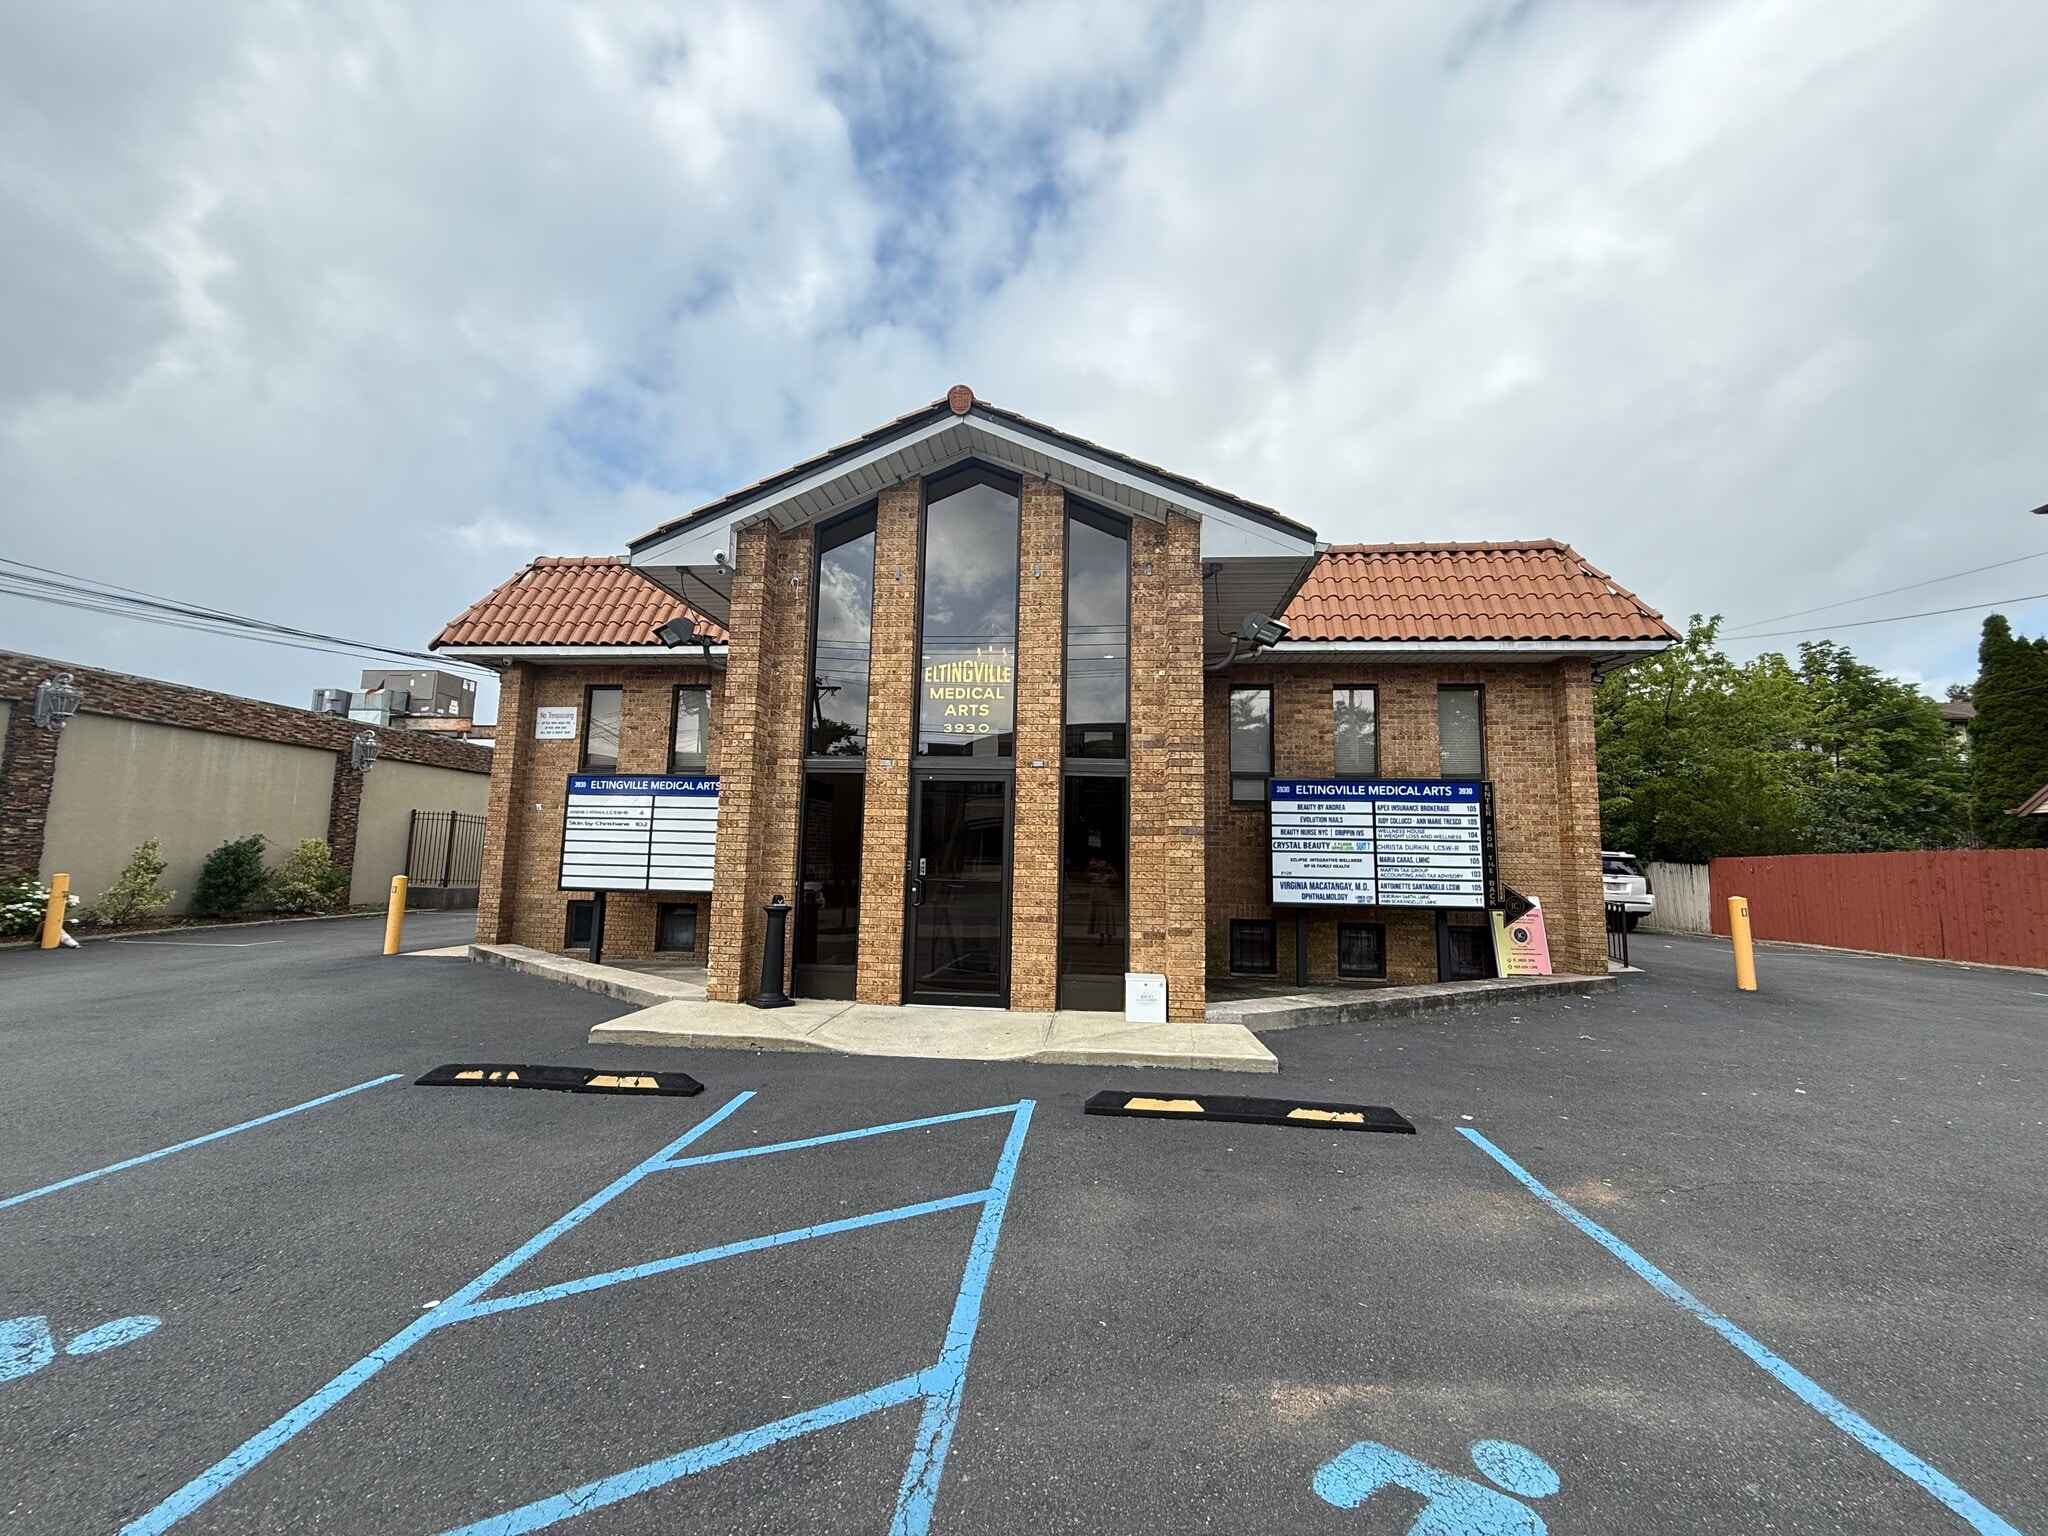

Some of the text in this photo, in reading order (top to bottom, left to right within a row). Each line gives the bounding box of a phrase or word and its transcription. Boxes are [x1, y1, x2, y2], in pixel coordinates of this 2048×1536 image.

[924, 659, 1011, 683] ELTINGVILLE
[929, 687, 1005, 700] MEDICAL
[944, 704, 990, 717] ARTS
[540, 711, 575, 720] No Trespassing
[943, 723, 989, 733] 3930
[590, 780, 649, 790] ELTINGVILLE
[650, 781, 695, 791] MEDICAL
[696, 781, 721, 791] ARTS
[1276, 784, 1473, 796] 3930 ELTINGVILLE MEDICAL ARTS 3930
[1297, 803, 1346, 811] BEAUTY BY ANDREA
[1377, 804, 1390, 812] APEX
[1391, 804, 1419, 812] INSURANCE
[1466, 805, 1477, 813] 105
[1328, 816, 1344, 824] NAILS
[1467, 818, 1478, 826] 105
[1280, 828, 1299, 836] BEAUTY
[1300, 828, 1317, 836] NURSE
[1318, 828, 1329, 836] NYC
[1334, 829, 1356, 837] DRIPPIN
[1355, 829, 1365, 837] IVS
[1467, 831, 1478, 839] 104
[1272, 841, 1331, 850] CRYSTAL BEAUTY
[1468, 844, 1479, 852] 105
[1484, 784, 1497, 907] ENTER FROM THE BACK
[1469, 857, 1480, 865] 105
[1470, 870, 1481, 878] 103
[1279, 880, 1370, 892] VIRGINIA MACATANGAY, M.D.
[1446, 883, 1461, 891] LCSW
[1471, 884, 1482, 892] 105
[1301, 892, 1349, 901] OPHTHALMOLOGY
